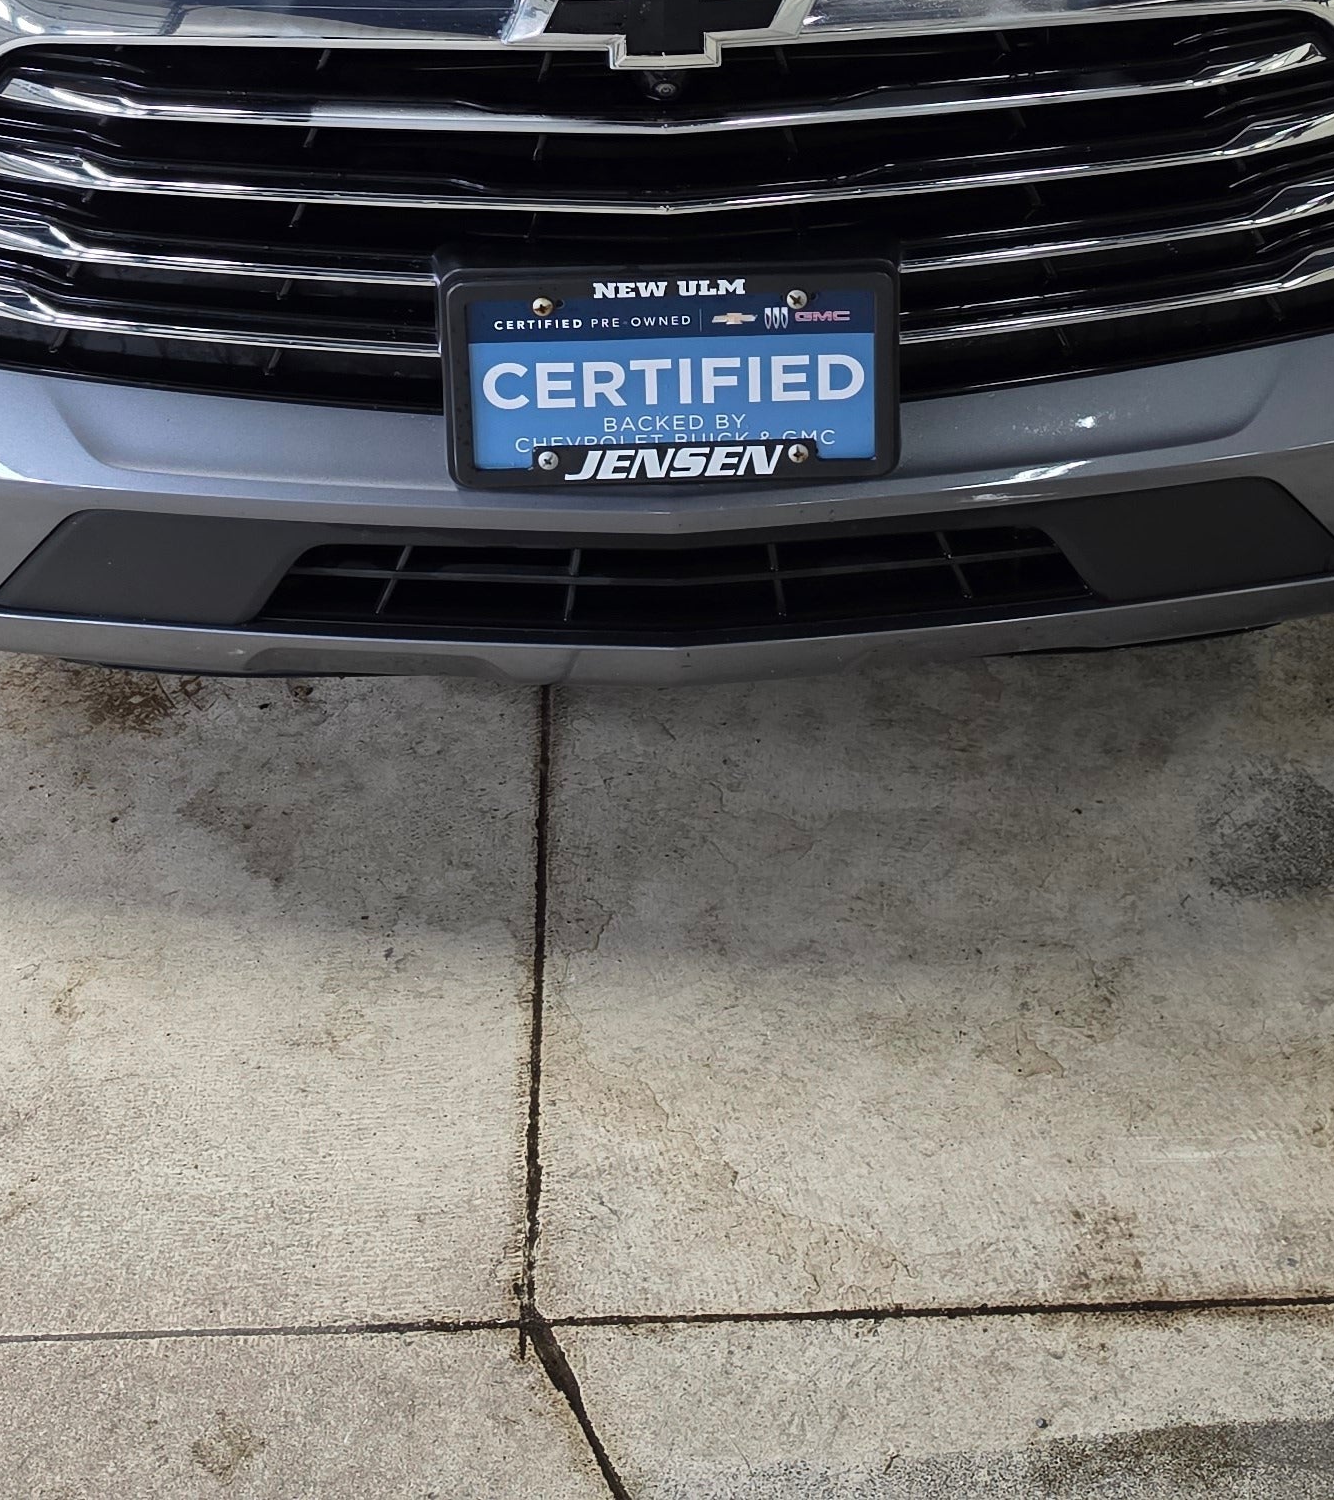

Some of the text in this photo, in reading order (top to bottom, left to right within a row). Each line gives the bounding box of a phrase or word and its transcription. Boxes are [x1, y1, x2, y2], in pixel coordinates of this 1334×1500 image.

[593, 278, 746, 299] NEW ULM
[493, 318, 583, 331] CERTIFIED
[795, 310, 851, 322] GMC
[482, 354, 865, 410] CERTIFIED
[603, 413, 746, 432] BACKED BY
[565, 444, 784, 481] JENSEN
